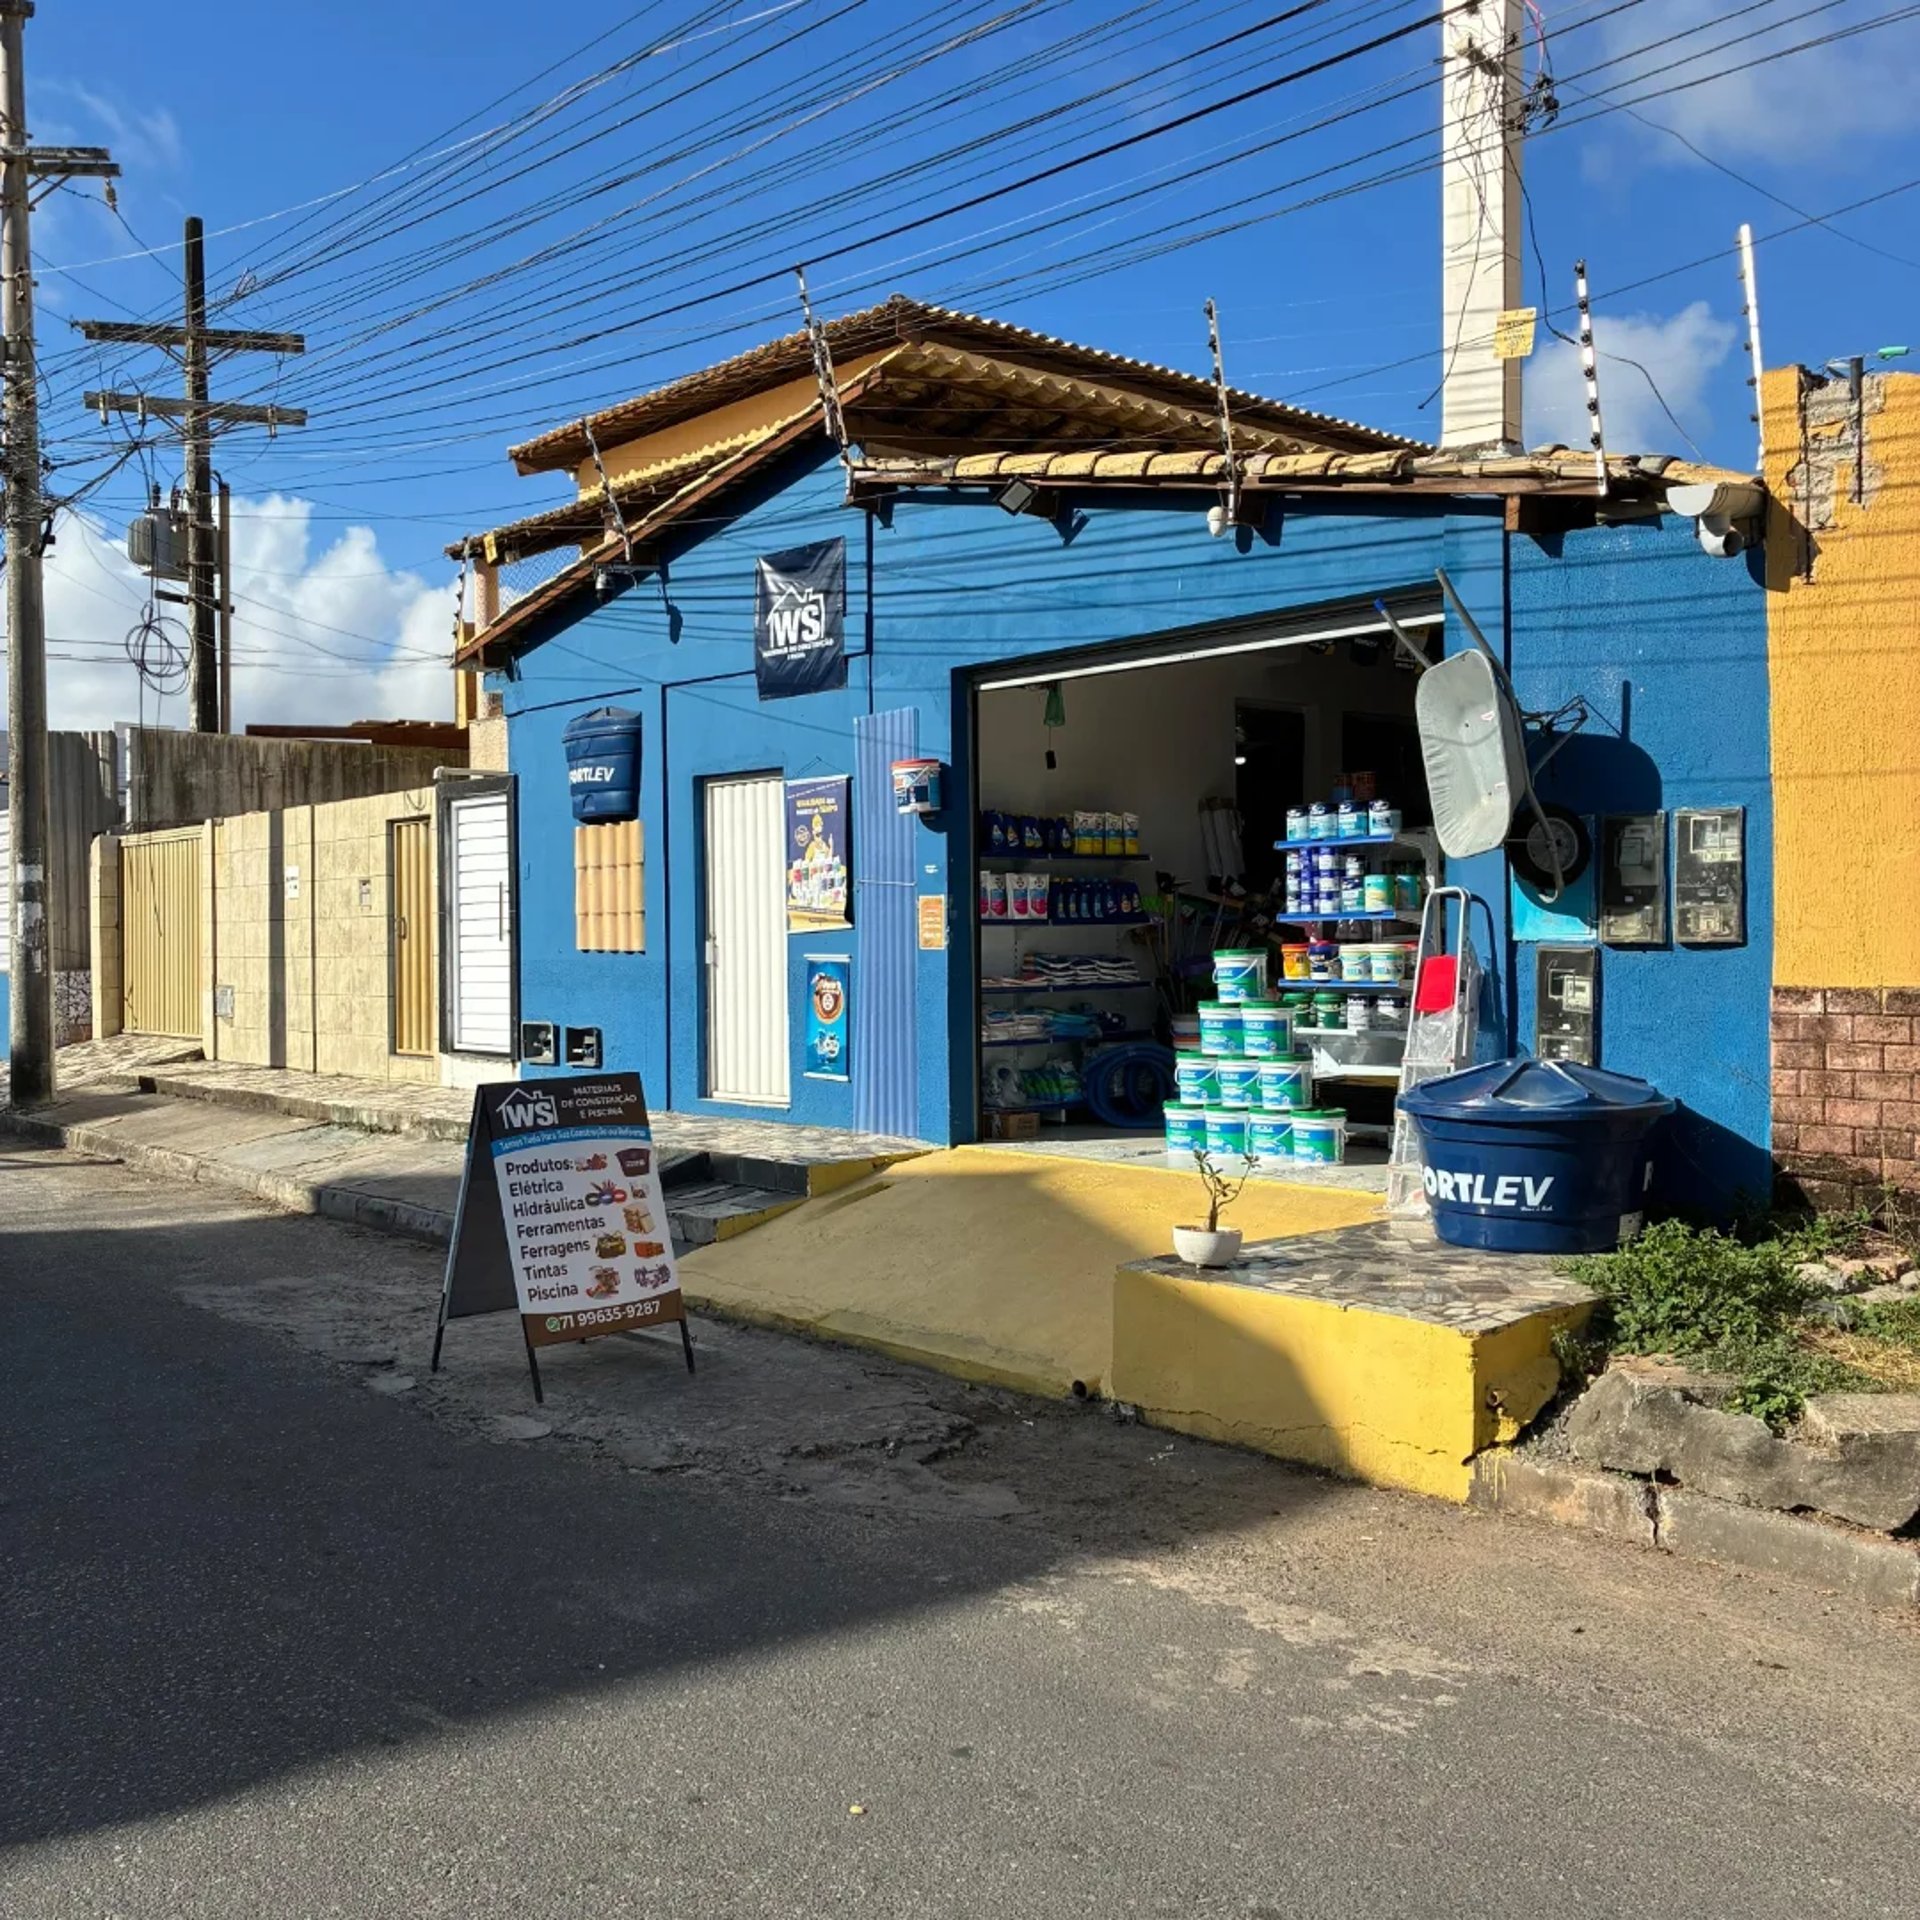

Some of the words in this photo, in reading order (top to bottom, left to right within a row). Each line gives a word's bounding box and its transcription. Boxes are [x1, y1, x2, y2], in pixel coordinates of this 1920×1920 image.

[773, 604, 821, 647] WS
[573, 1083, 622, 1096] MATERIAIS
[561, 1098, 574, 1109] DE
[576, 1092, 638, 1107] CONSTRUÇÃO
[507, 1101, 554, 1128] WS
[580, 1109, 587, 1119] E
[588, 1106, 624, 1118] PISCINA
[506, 1158, 574, 1176] Produtos:
[509, 1177, 564, 1198] Elétrica
[513, 1197, 585, 1218] Hidráulica
[517, 1216, 606, 1239] Ferramentas
[520, 1240, 591, 1259] Ferragens
[522, 1264, 568, 1281] Tintas
[528, 1282, 579, 1302] Piscina
[560, 1314, 575, 1330] 71
[577, 1300, 660, 1327] 99635-9287
